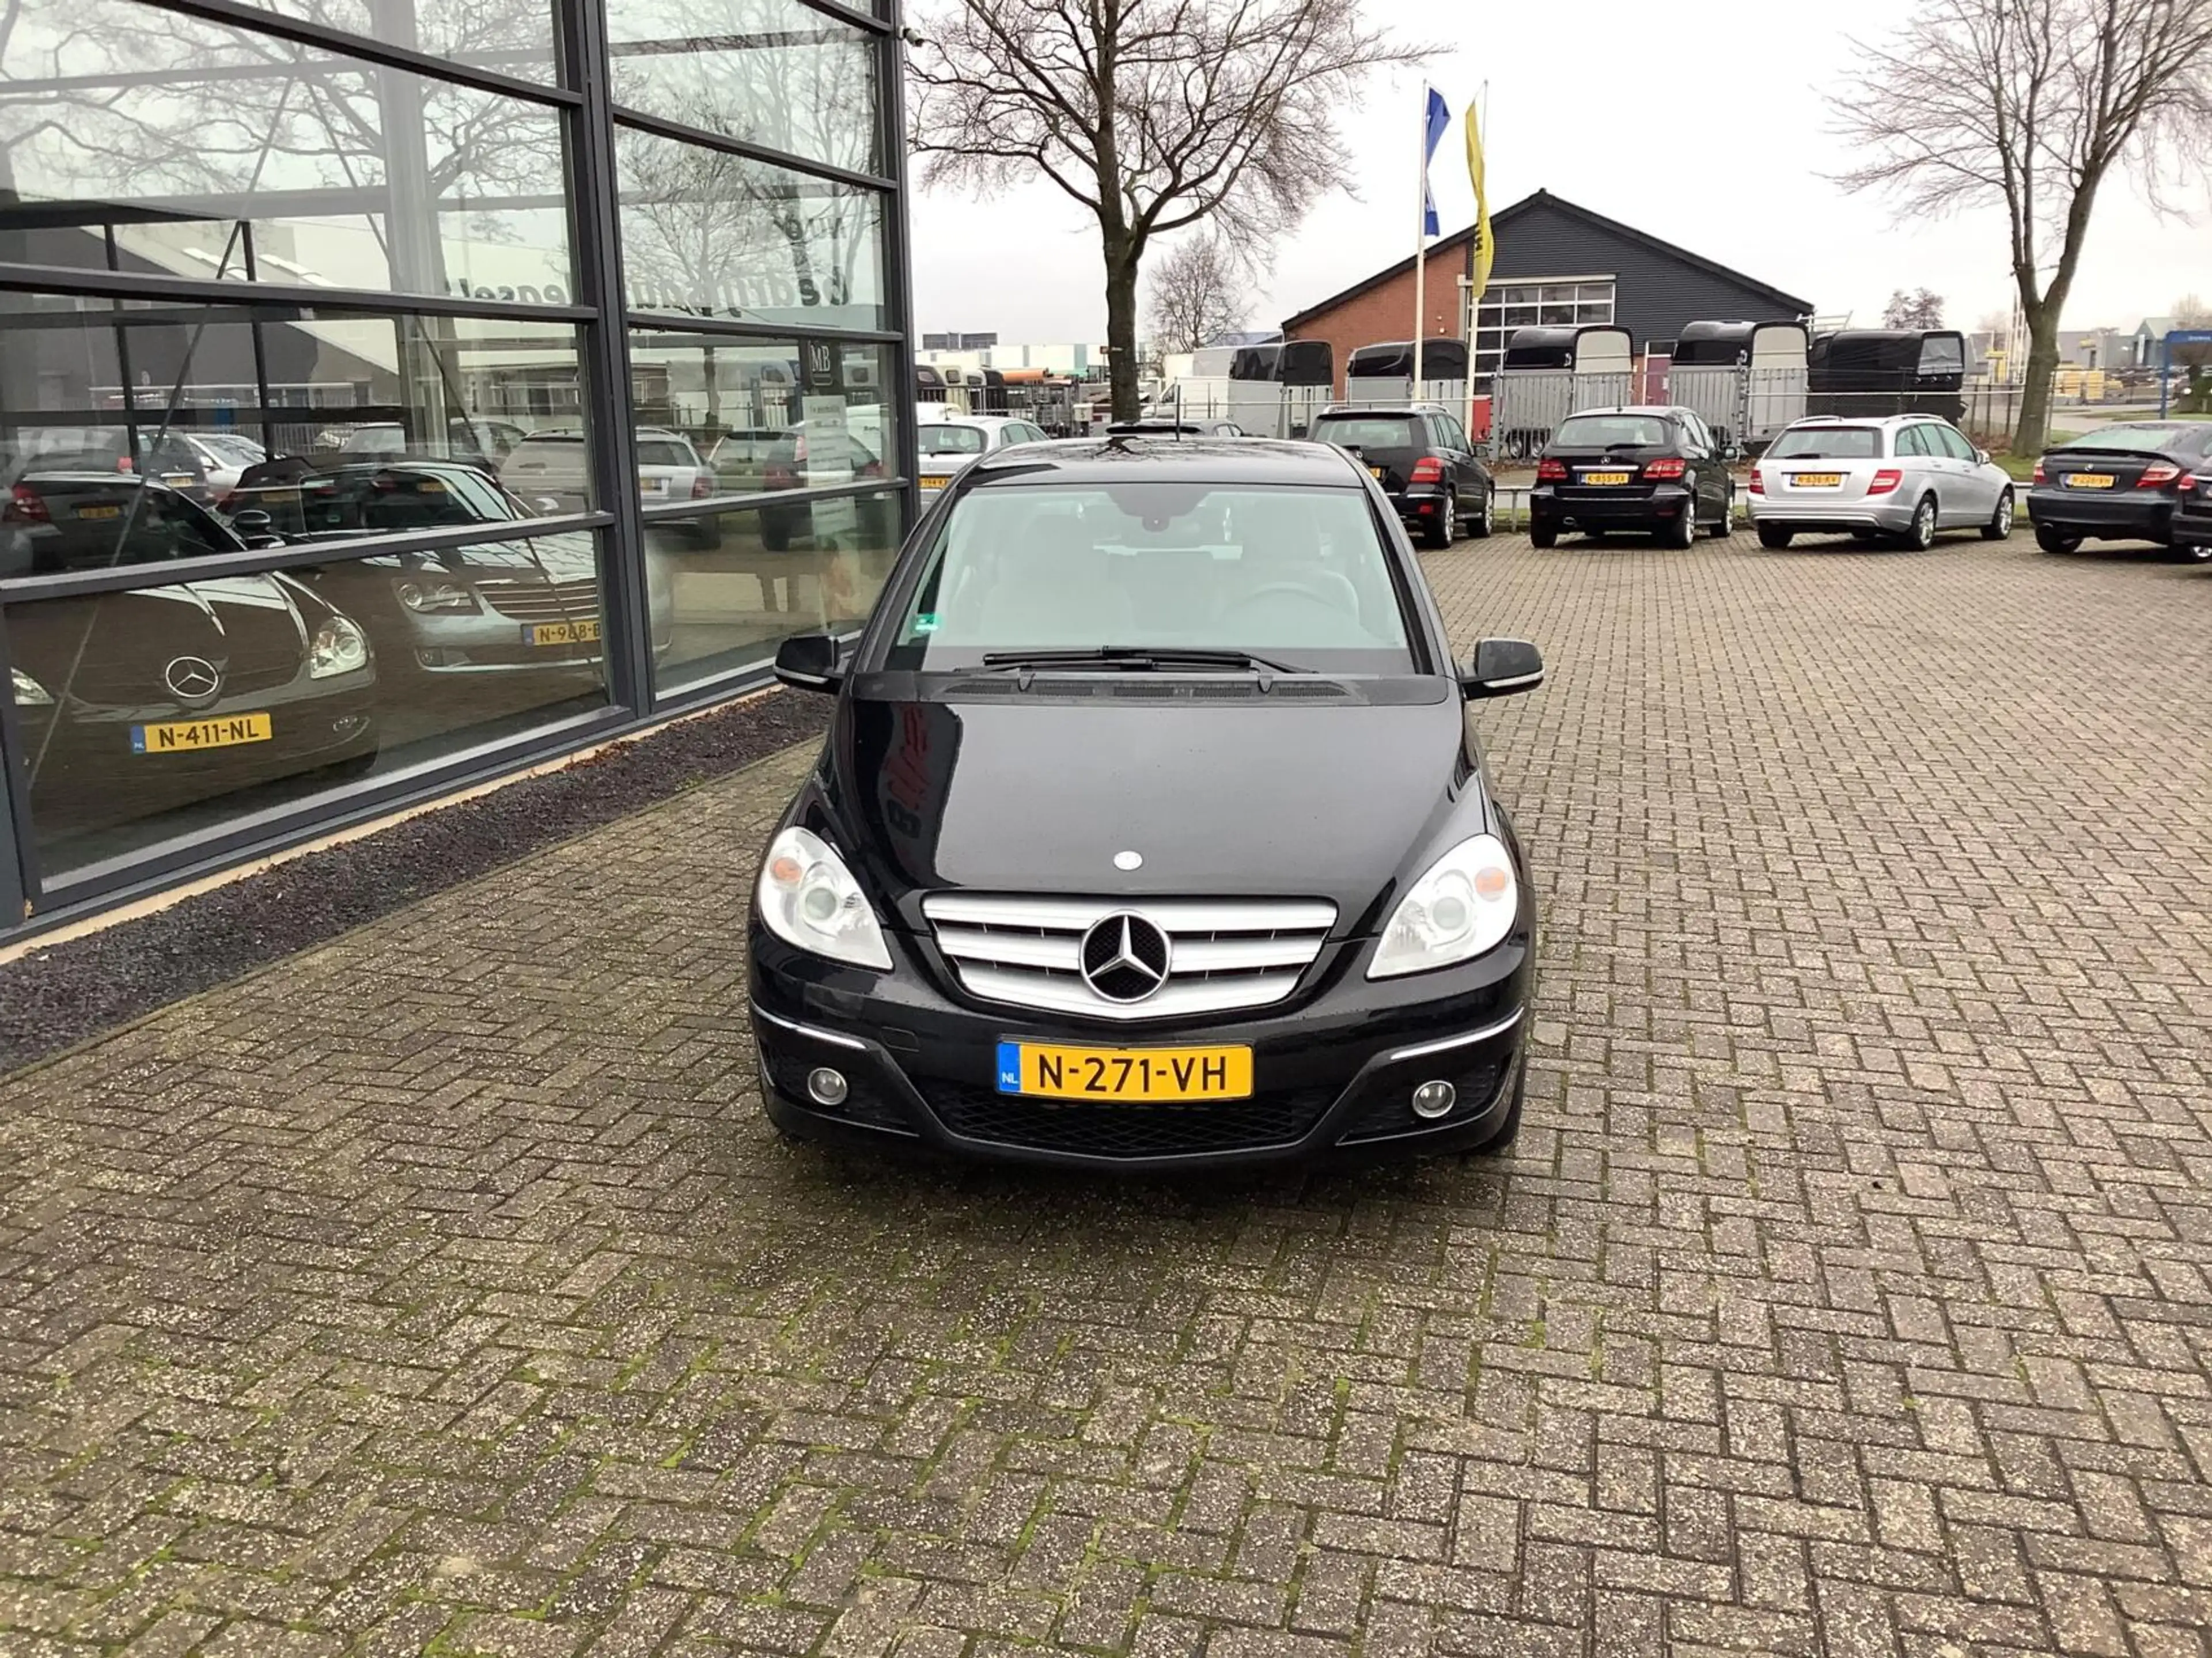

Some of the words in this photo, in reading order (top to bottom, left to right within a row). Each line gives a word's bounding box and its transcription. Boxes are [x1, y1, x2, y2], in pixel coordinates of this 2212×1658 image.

[159, 719, 259, 747] N-411-NL
[1001, 1073, 1018, 1084] NL
[1039, 1053, 1226, 1092] N-271-VH
